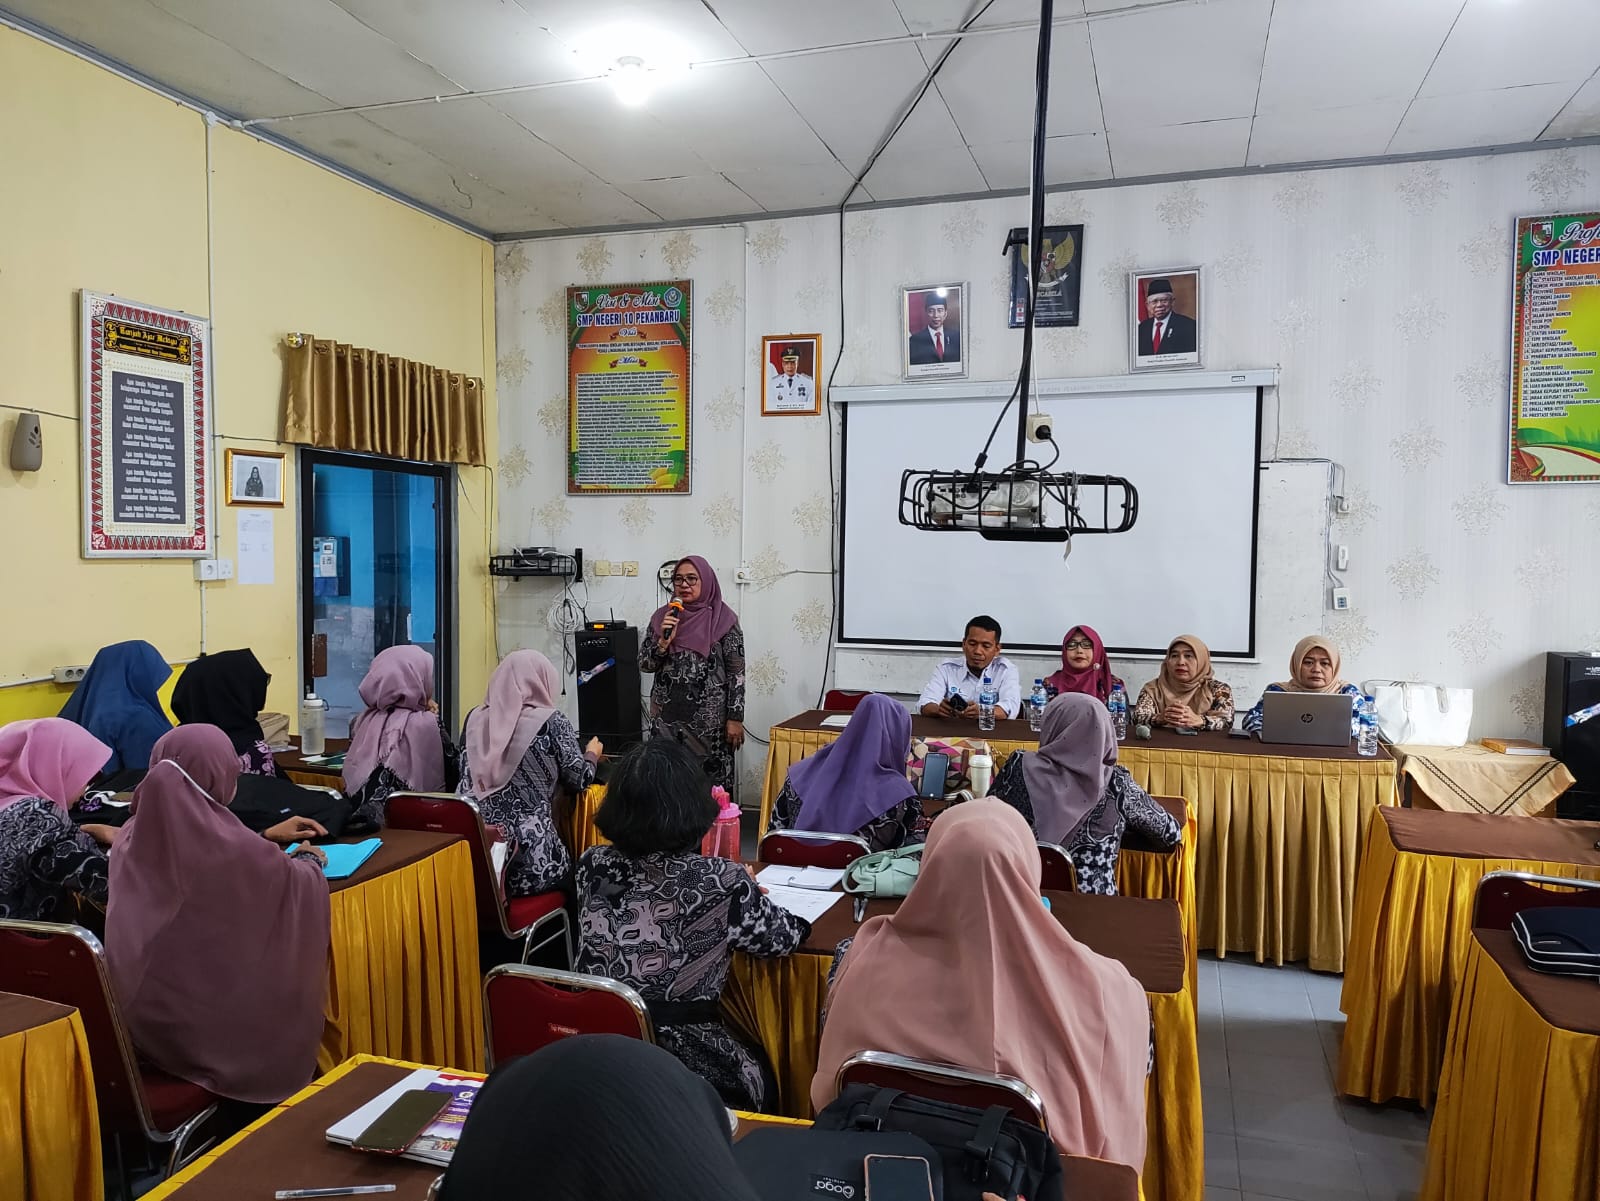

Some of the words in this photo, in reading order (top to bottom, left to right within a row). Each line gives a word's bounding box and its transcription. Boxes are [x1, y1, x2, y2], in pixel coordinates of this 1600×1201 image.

[1533, 250, 1560, 266] SMP
[597, 294, 616, 308] Visi
[620, 293, 630, 308] &
[633, 292, 660, 307] Misi
[576, 314, 593, 326] SMP
[596, 313, 622, 326] NEGERI
[624, 312, 634, 324] 10
[635, 310, 680, 324] PEKANBARU
